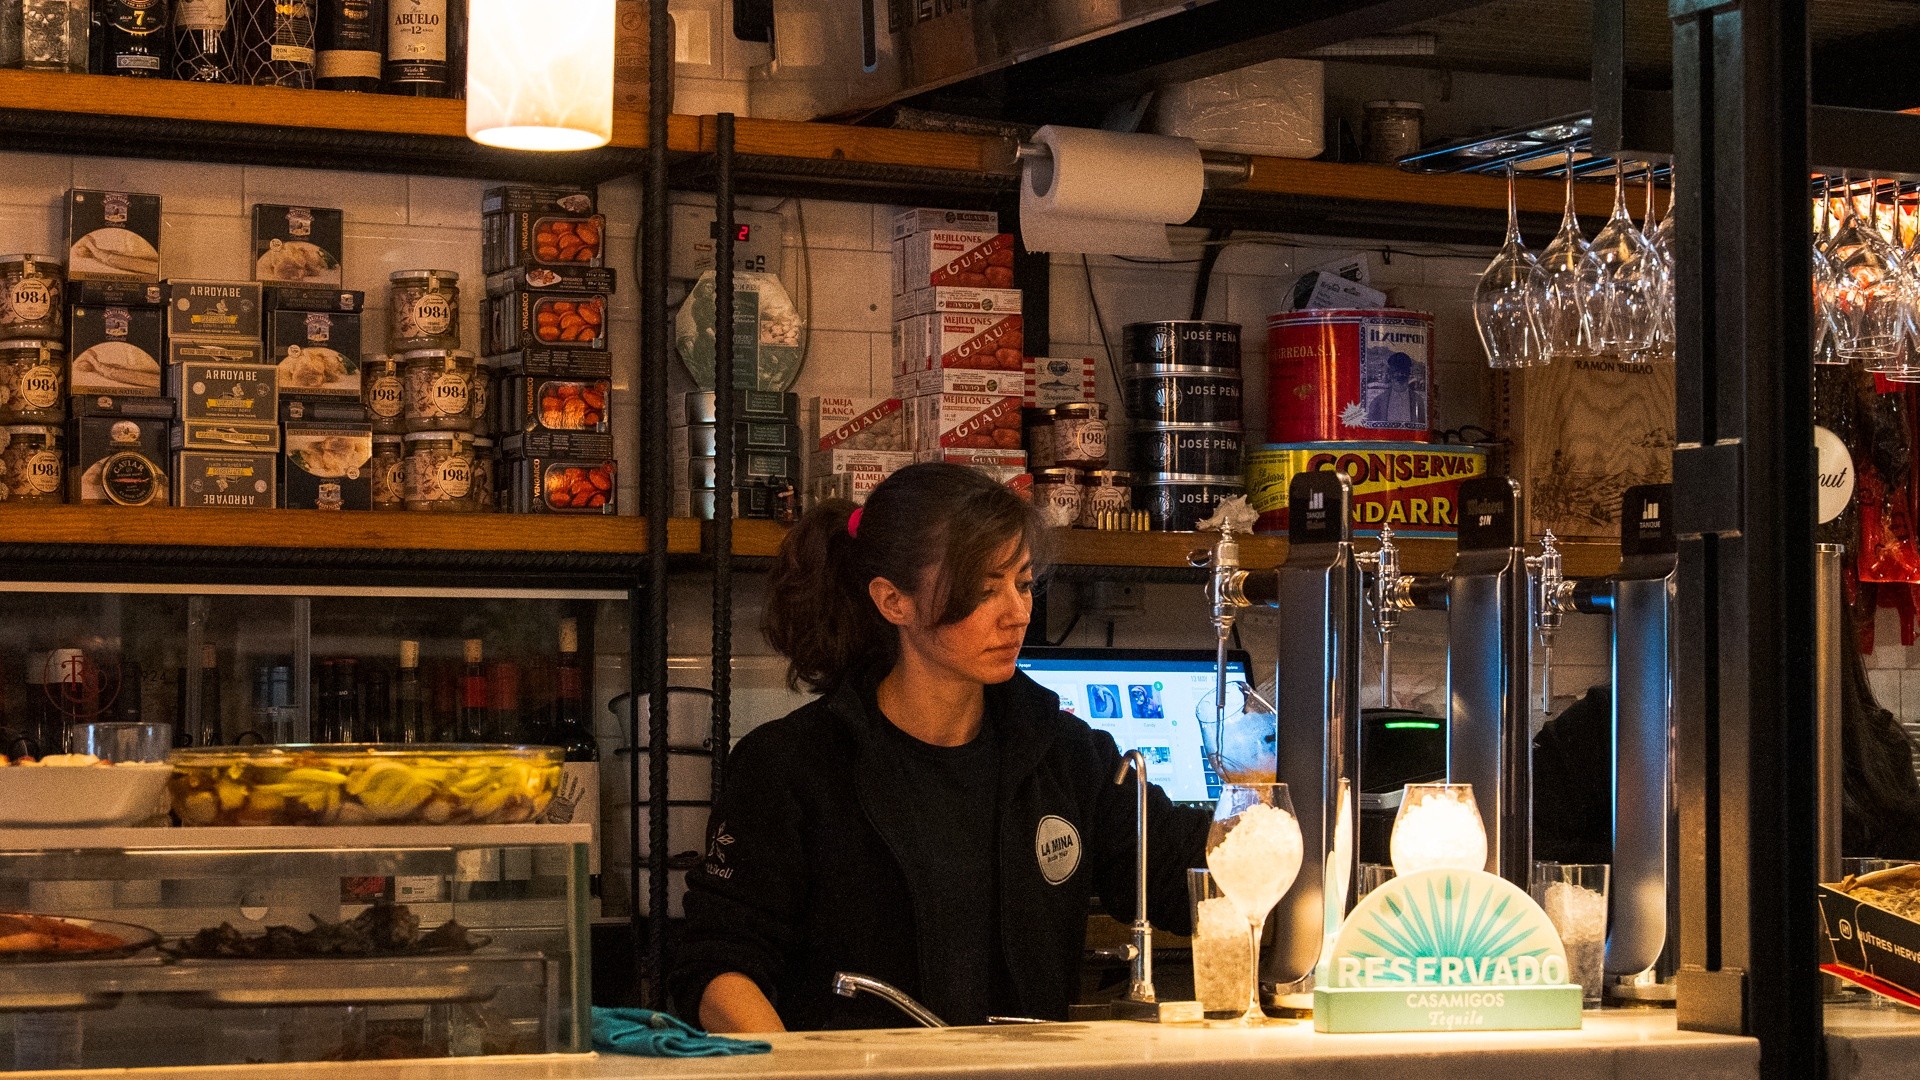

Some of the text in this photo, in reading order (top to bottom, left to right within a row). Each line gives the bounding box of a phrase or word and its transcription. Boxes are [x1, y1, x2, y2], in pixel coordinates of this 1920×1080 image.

[134, 10, 145, 25] 7
[395, 14, 440, 25] ABUELO
[411, 26, 422, 34] 12
[739, 226, 749, 240] 2
[933, 233, 982, 243] MEJILLONES
[15, 291, 48, 304] 1984
[190, 286, 241, 297] ARROYABE
[418, 306, 449, 318] 1984
[944, 316, 992, 325] MEJILLONES
[1183, 330, 1237, 342] JOSÉ PEÑA
[1575, 361, 1654, 375] RAMÓN BILBAO
[206, 370, 257, 381] ARROYABE
[27, 378, 57, 392] 1984
[1186, 384, 1240, 397] JOSÉ PEÑA
[372, 389, 403, 401] 1984
[437, 386, 467, 398] 1984
[822, 398, 853, 407] ALMEJA
[943, 395, 991, 405] MEJILLONES
[822, 408, 855, 416] BLANCA
[1180, 437, 1238, 450] JOSÉ PEÑA
[32, 463, 60, 477] 1984
[113, 460, 145, 474] CAVIAR
[1307, 453, 1474, 486] CONSERVAS
[392, 471, 405, 484] 19
[442, 469, 469, 481] 1984
[854, 482, 876, 490] BLAN
[203, 494, 254, 505] ARROYABE
[1479, 515, 1492, 526] SIN
[1041, 834, 1074, 857] LA MINA
[1338, 955, 1566, 988] RESERVADO
[1406, 993, 1505, 1009] CASAMIGOS
[1428, 1010, 1485, 1030] Tequila
